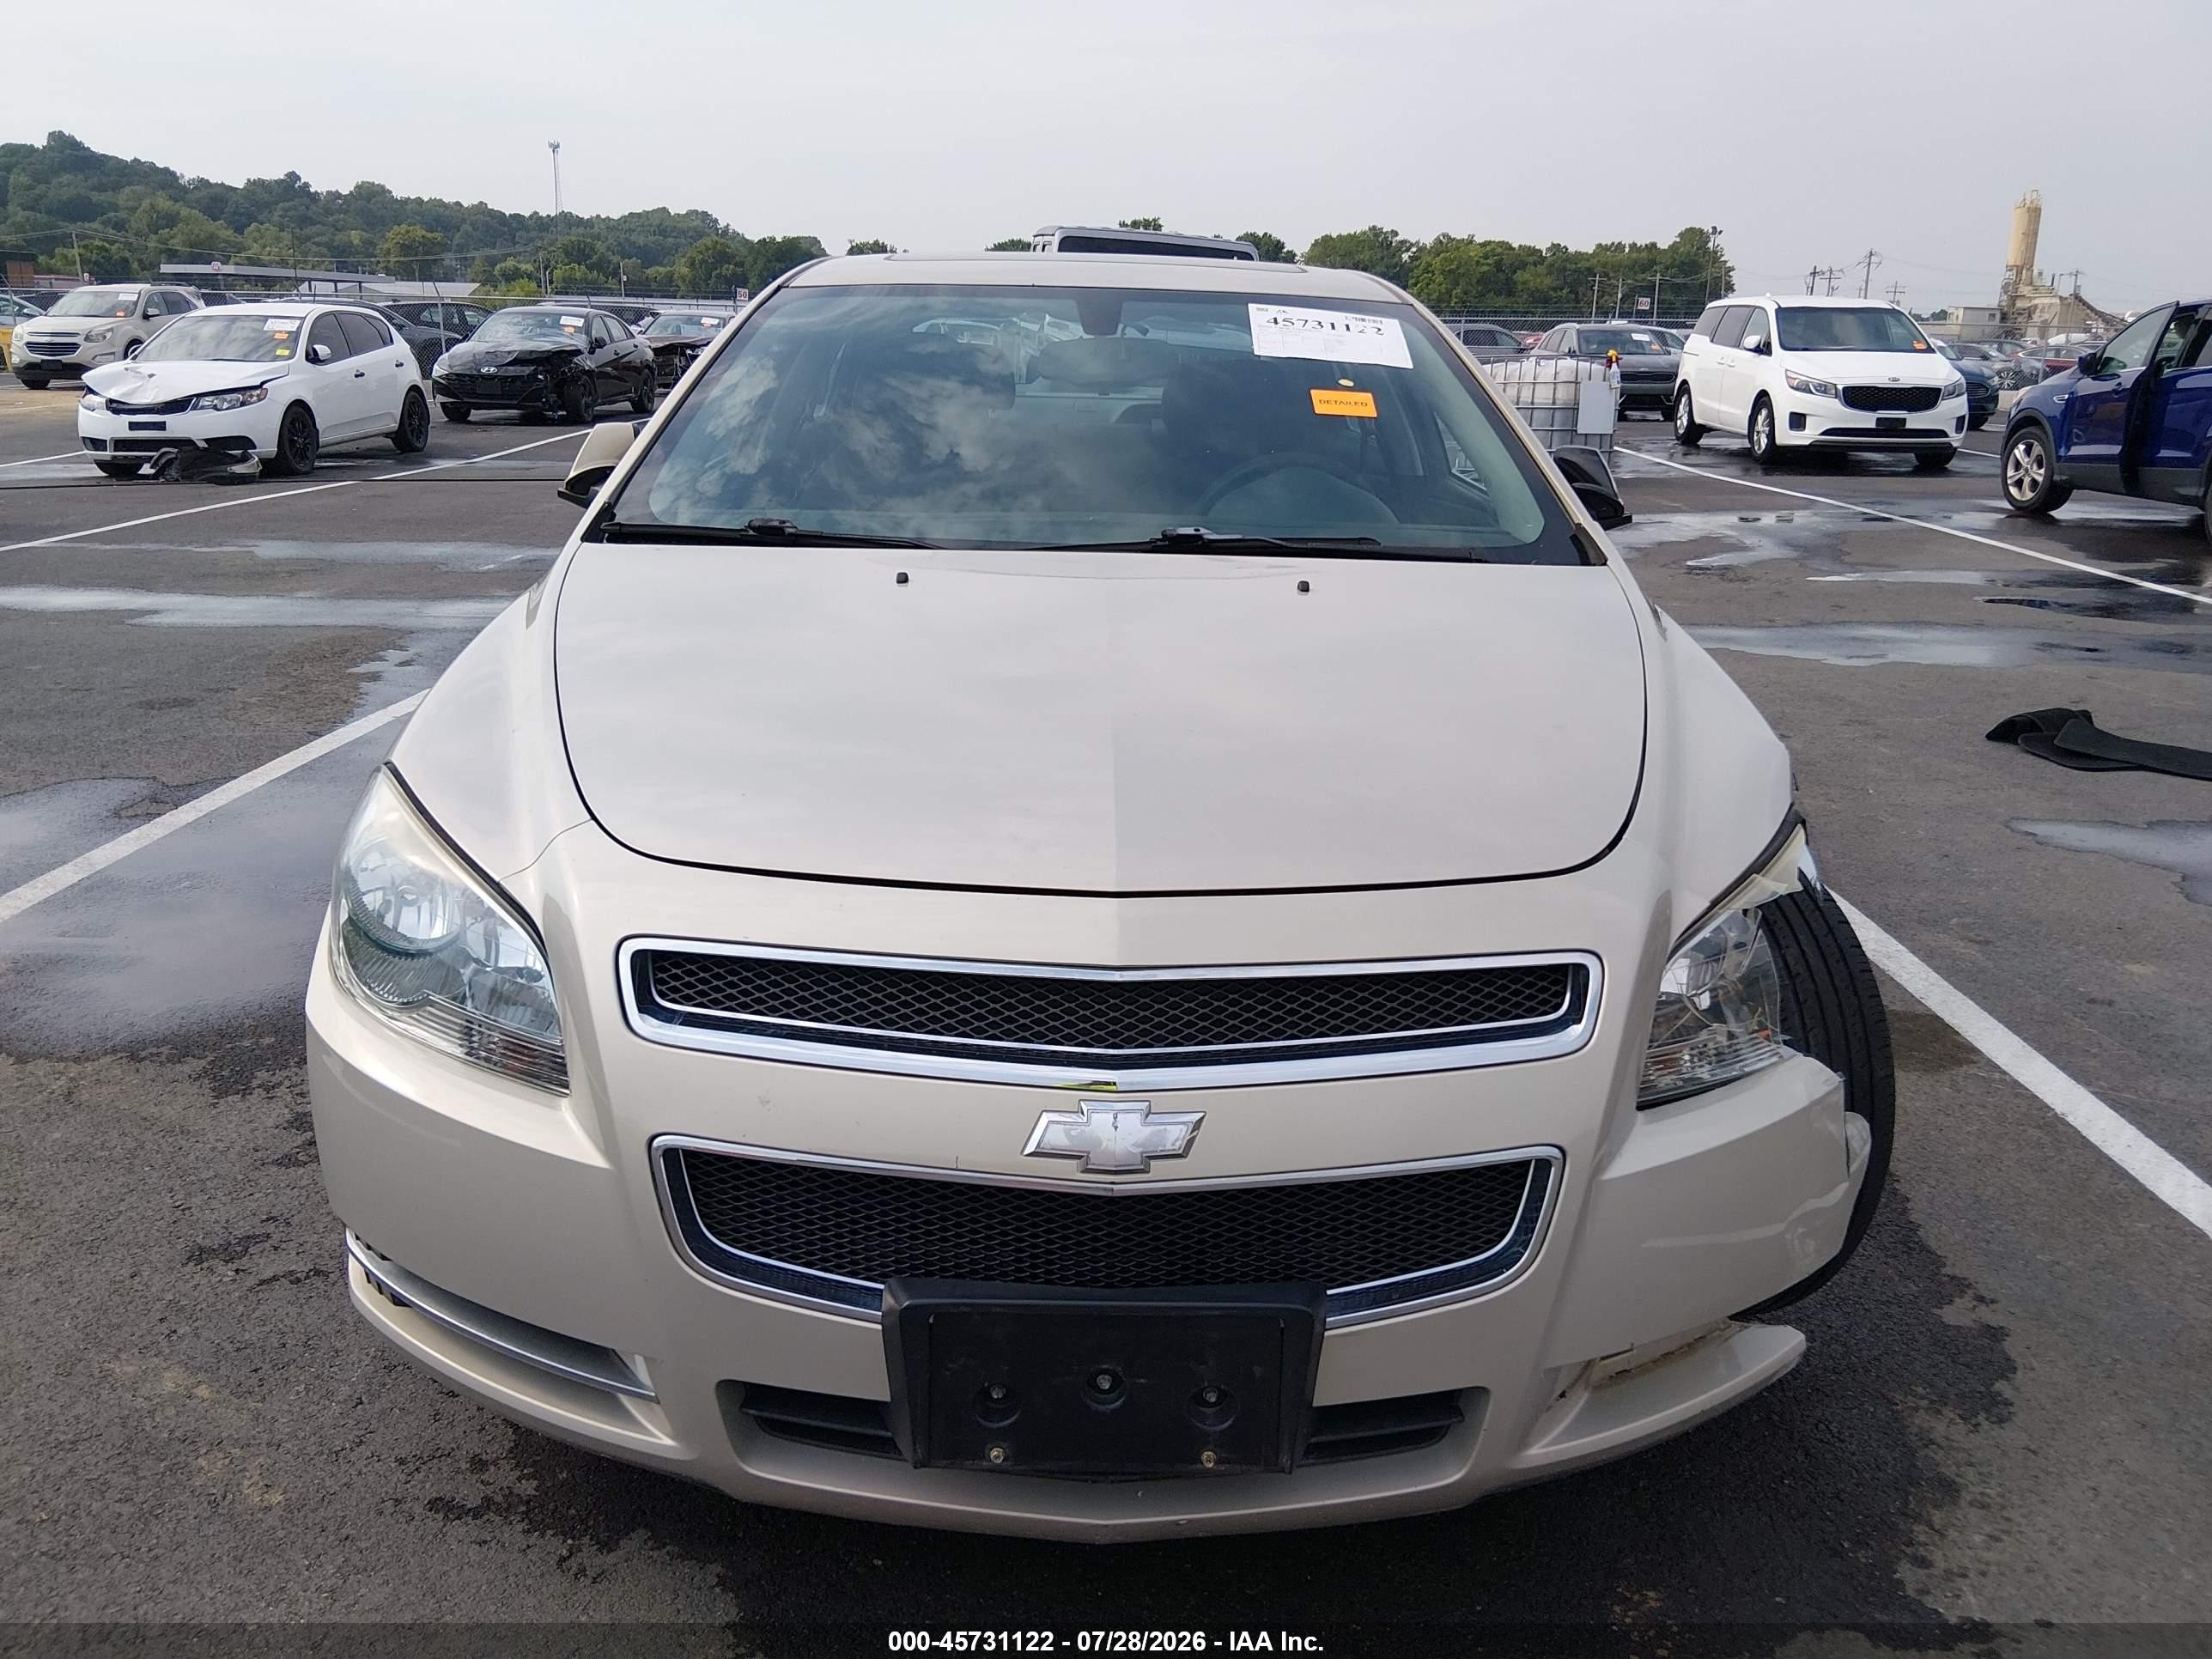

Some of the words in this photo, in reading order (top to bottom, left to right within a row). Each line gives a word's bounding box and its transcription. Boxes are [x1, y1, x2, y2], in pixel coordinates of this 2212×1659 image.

[738, 290, 747, 299] 50
[1266, 316, 1385, 336] 45731122
[1318, 398, 1368, 407] DETAILED
